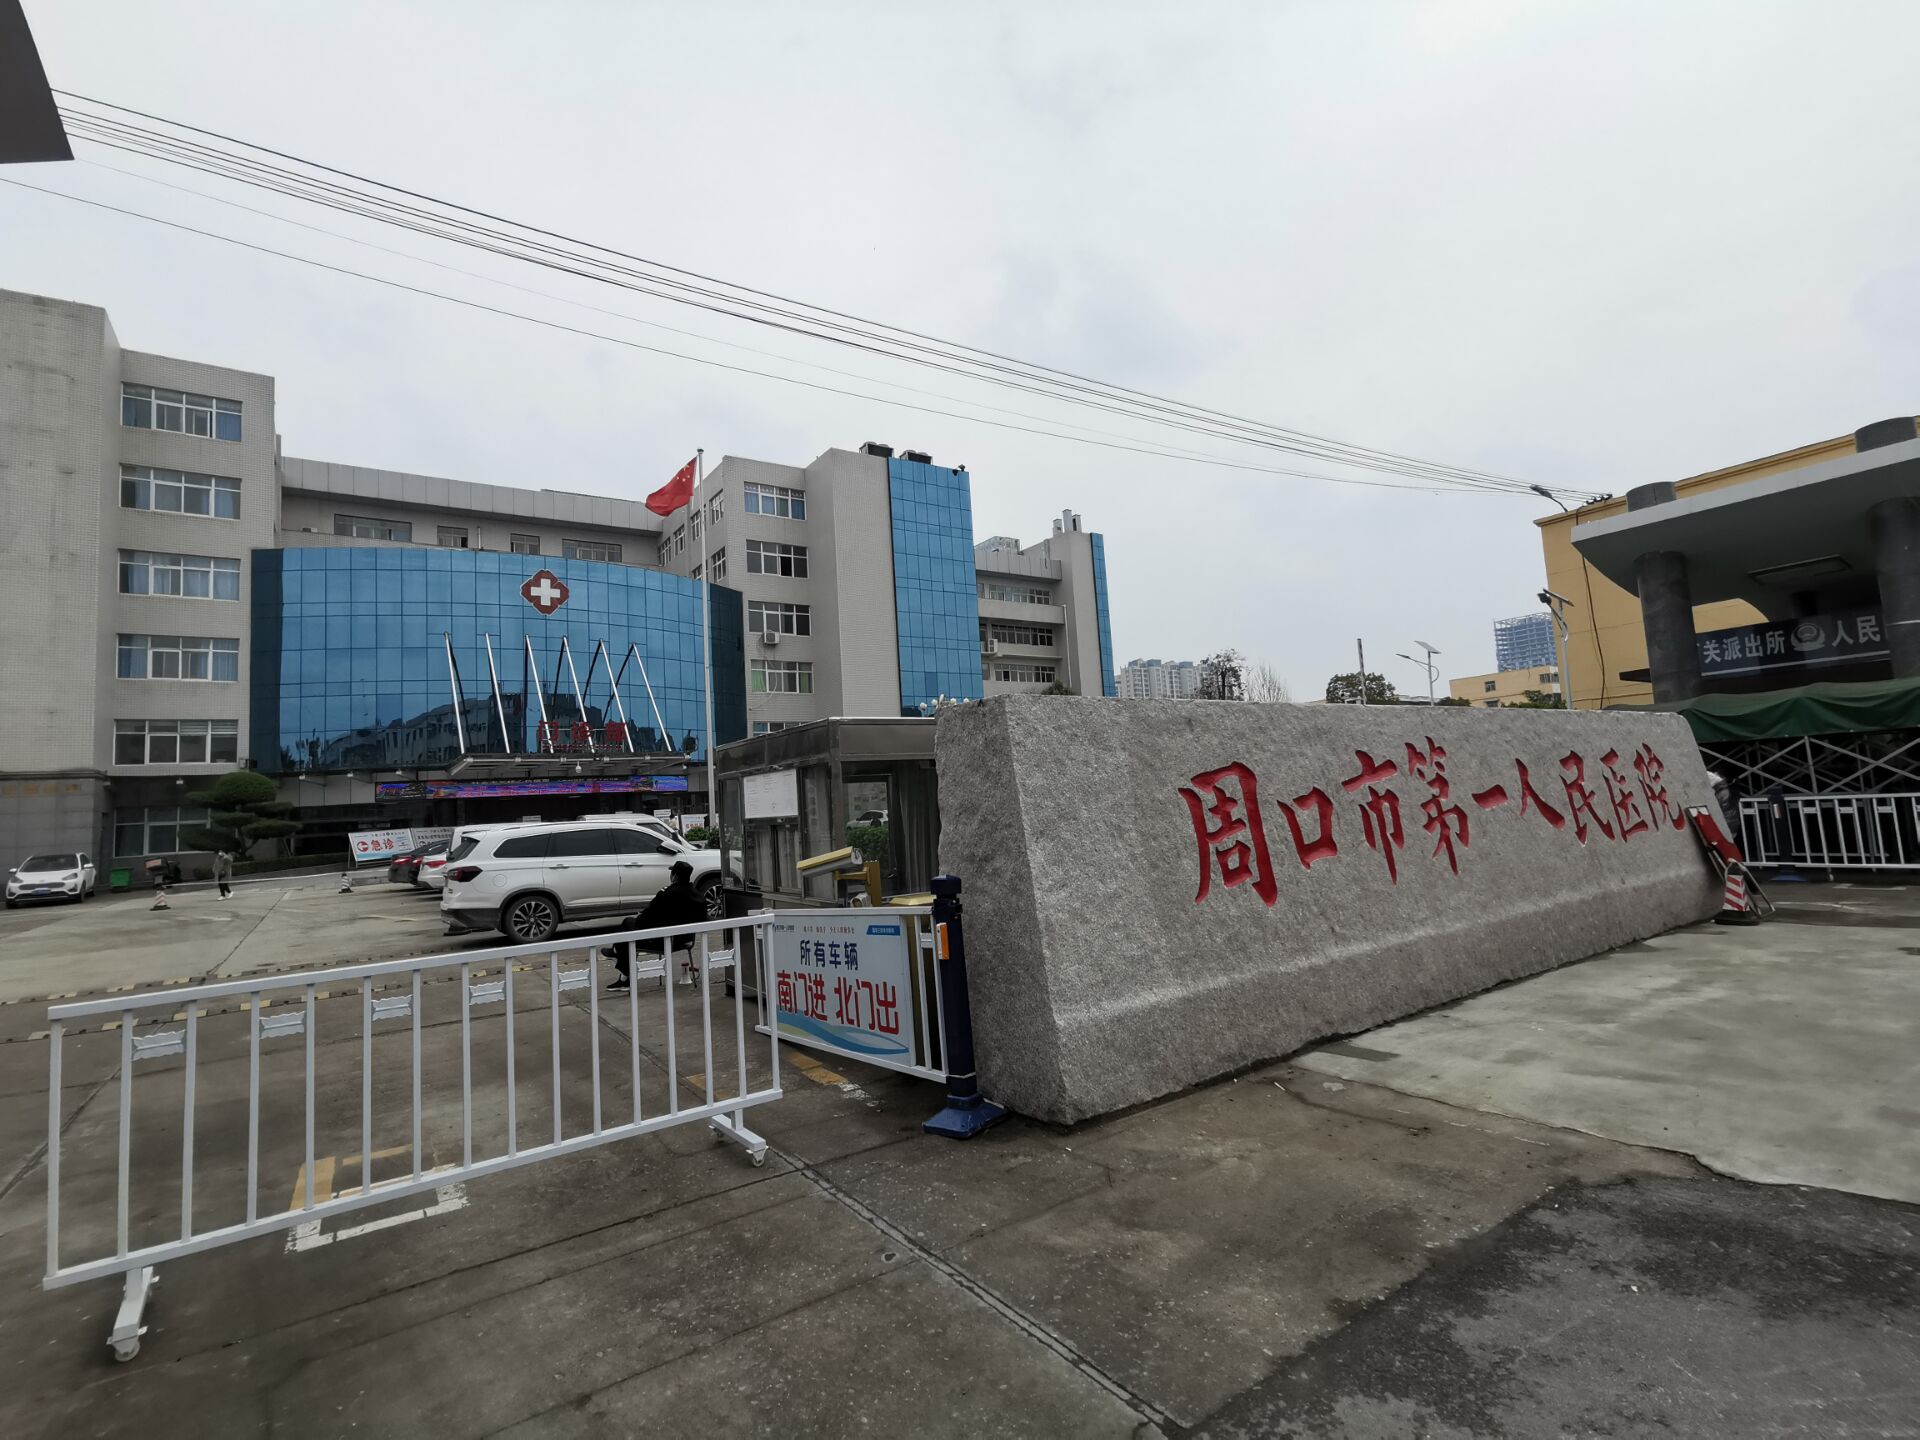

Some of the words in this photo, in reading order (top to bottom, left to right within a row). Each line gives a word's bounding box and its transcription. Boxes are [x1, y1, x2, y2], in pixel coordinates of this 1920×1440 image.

[1703, 630, 1785, 664] 关派出所
[1831, 615, 1880, 648] 人民
[370, 838, 394, 852] 急诊
[1178, 735, 1686, 907] 周口市第一人民医院
[800, 939, 859, 971] 所有车辆
[777, 969, 828, 1021] 南门进
[834, 976, 899, 1036] 北门出
